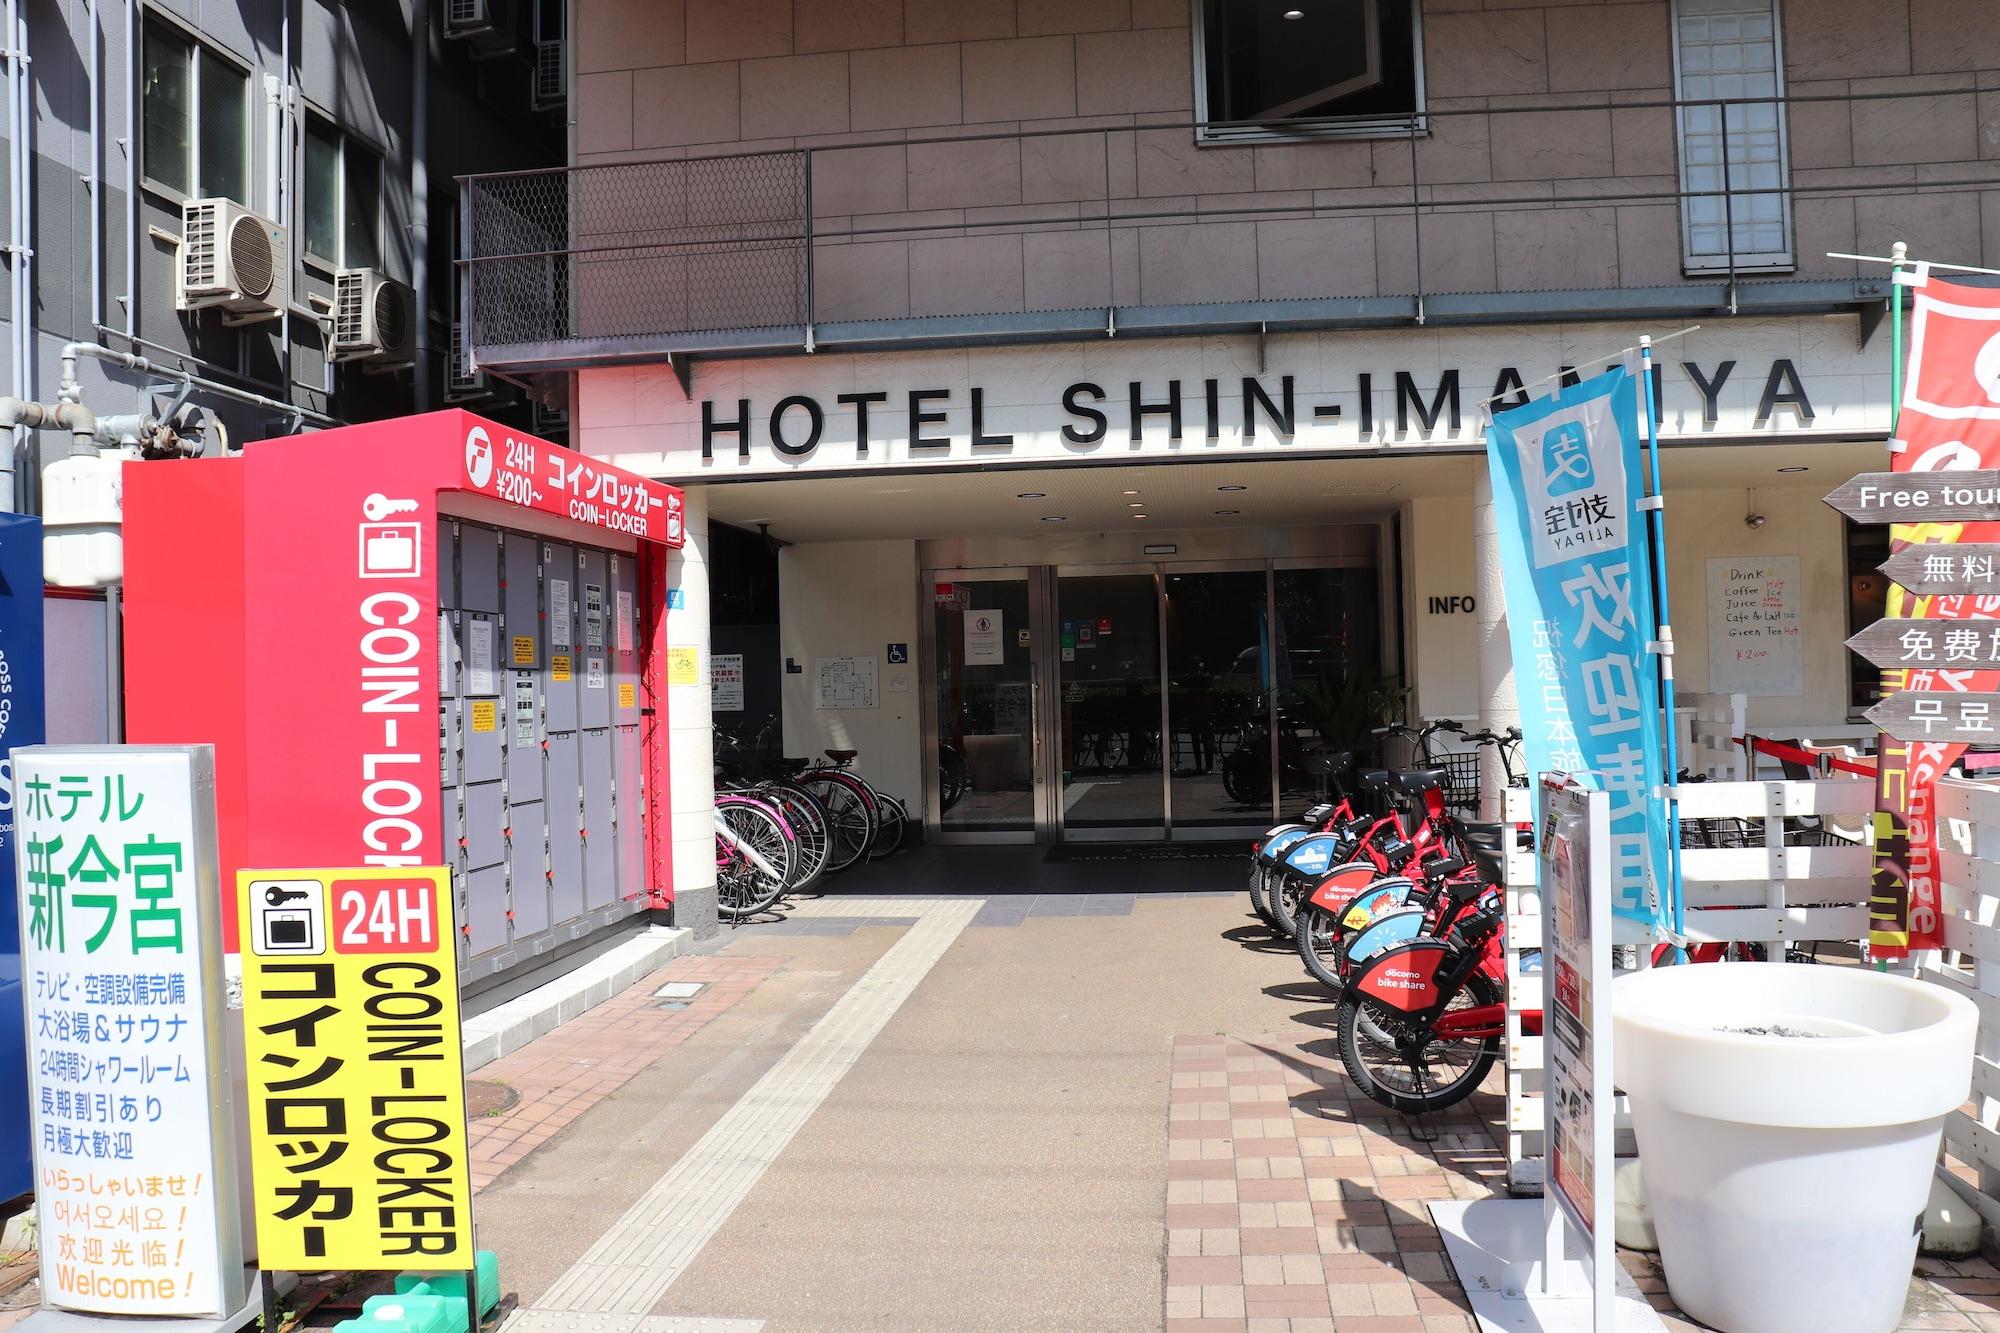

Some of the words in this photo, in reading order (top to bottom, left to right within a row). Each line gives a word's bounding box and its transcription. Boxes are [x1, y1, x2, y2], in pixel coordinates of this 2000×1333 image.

[701, 387, 1014, 459] HOTEL
[1061, 359, 1816, 445] SHIN-IMAIYA
[505, 437, 535, 475] 24H
[548, 453, 663, 515] コインロッカー
[1860, 486, 1930, 508] Free
[1941, 486, 2000, 506] tou
[569, 499, 648, 537] COIN-LOCKER
[1731, 569, 1765, 581] Drink
[1923, 553, 1996, 583] 無料
[1429, 596, 1475, 614] INFO
[1725, 586, 1759, 596] Coffee
[1908, 699, 1995, 734] 무료
[24, 773, 144, 825] ホテル
[26, 833, 184, 957] 新今宮
[340, 886, 432, 947] 24H
[36, 970, 186, 1006] テレビ・空調設備完備
[1377, 977, 1398, 988] bike
[1399, 978, 1426, 990] share
[40, 1049, 191, 1085] 24時間シャワールーム
[41, 1086, 162, 1124] 長期割引あり
[258, 962, 354, 1258] コインロッカー
[361, 962, 457, 1257] COIN-LOCKER
[43, 1123, 135, 1160] 月極大歓迎
